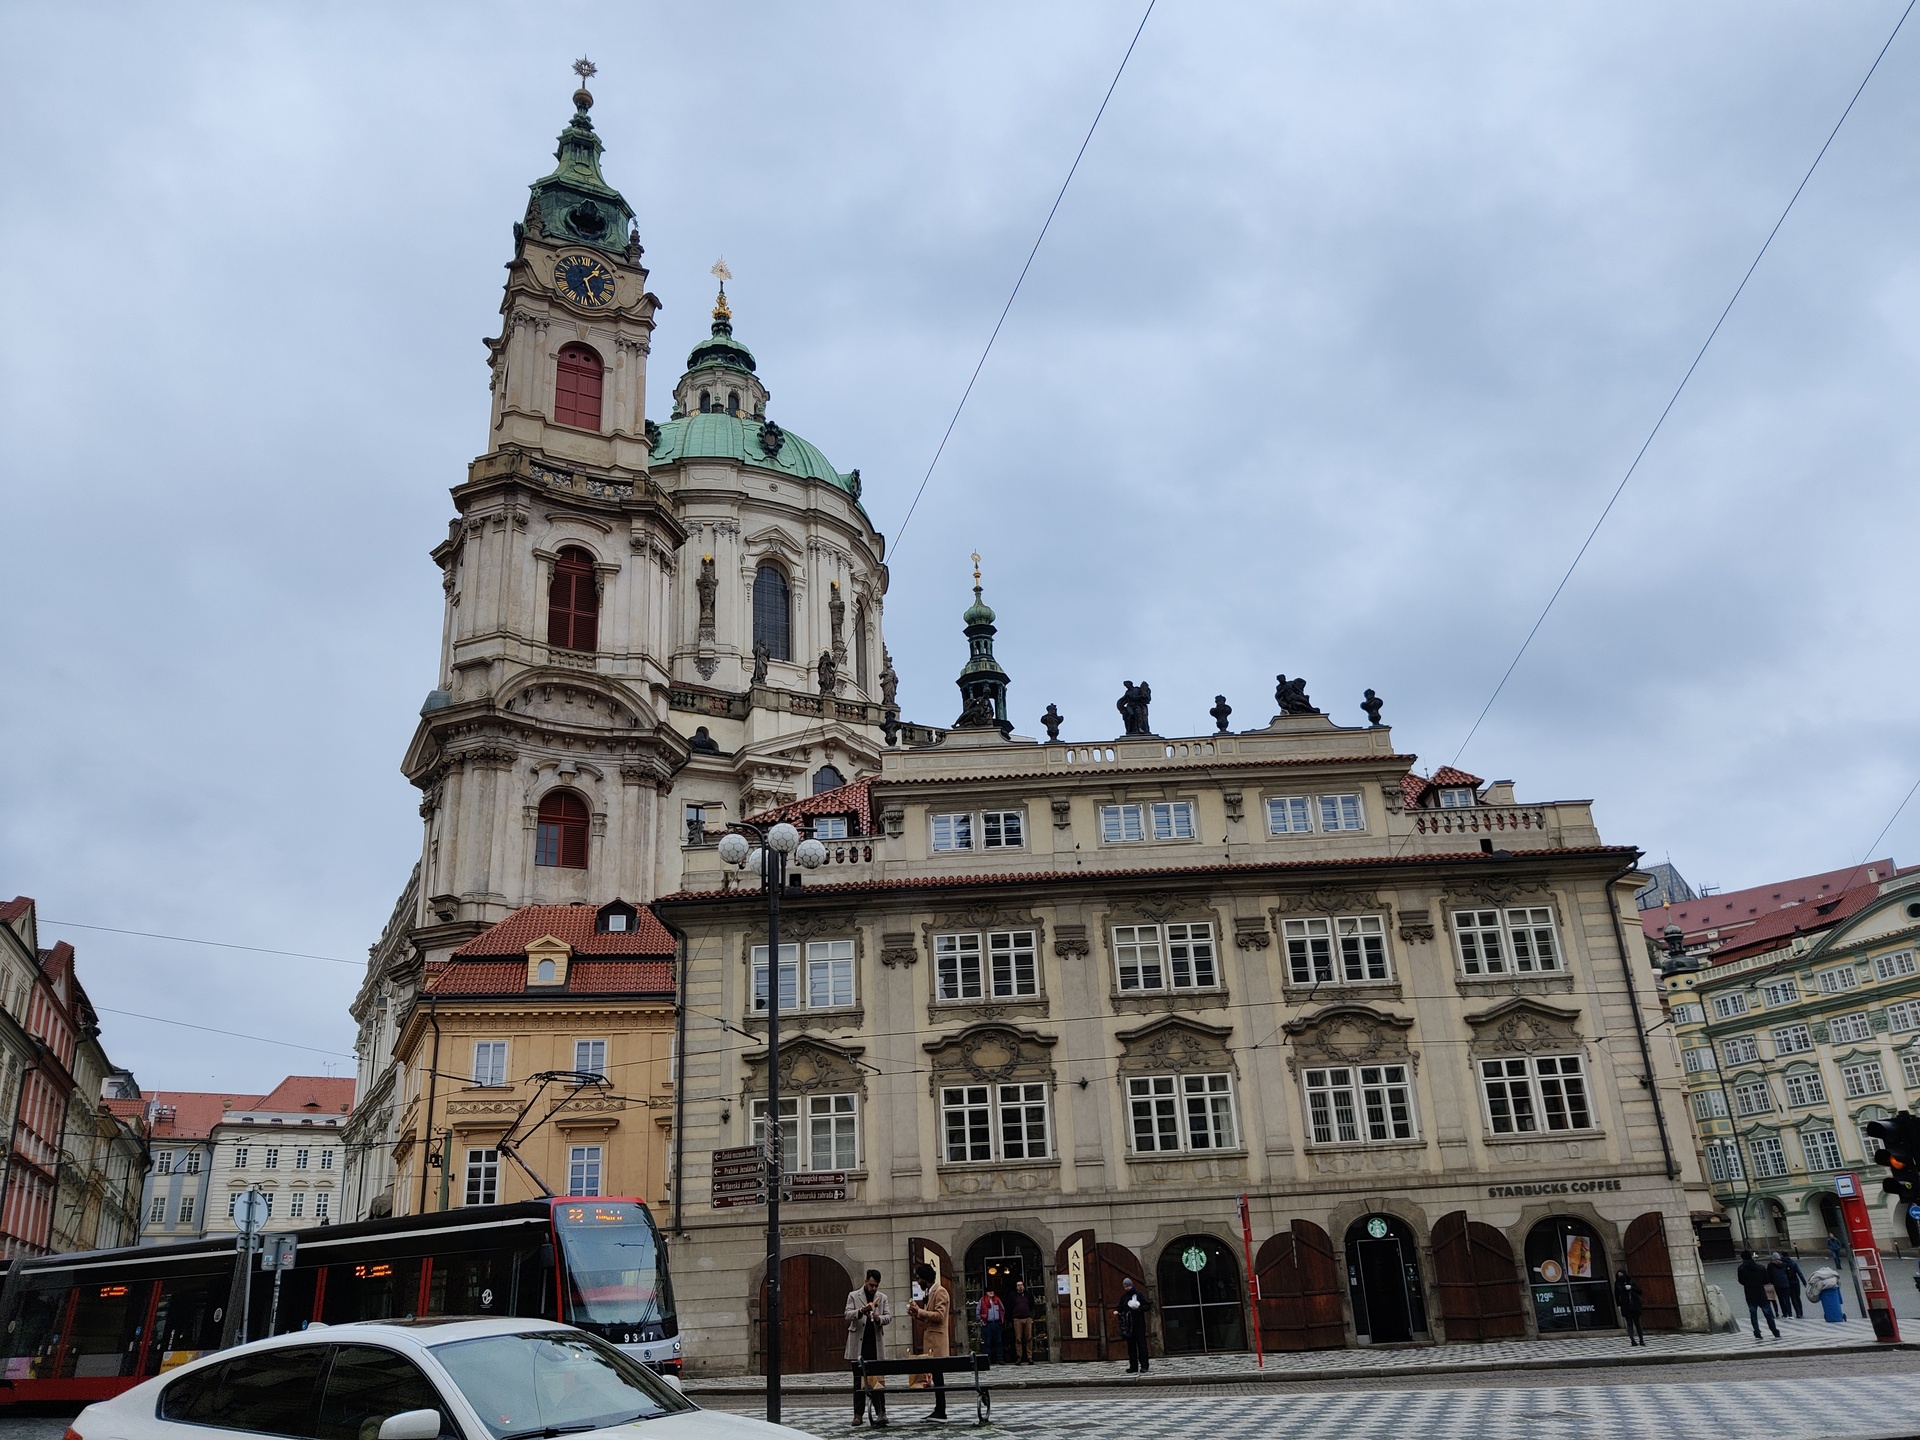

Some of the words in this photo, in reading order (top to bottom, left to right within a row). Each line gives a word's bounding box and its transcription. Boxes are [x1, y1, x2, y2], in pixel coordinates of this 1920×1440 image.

[559, 261, 570, 270] X
[569, 256, 579, 266] XI
[581, 256, 591, 267] XII
[1488, 1183, 1569, 1198] STARBUCKS
[1570, 1179, 1622, 1193] COFFEE
[808, 1222, 850, 1236] BAKERY
[1071, 1249, 1084, 1334] ANTIQUE
[1535, 1292, 1551, 1303] 129
[623, 1331, 654, 1343] 9317
